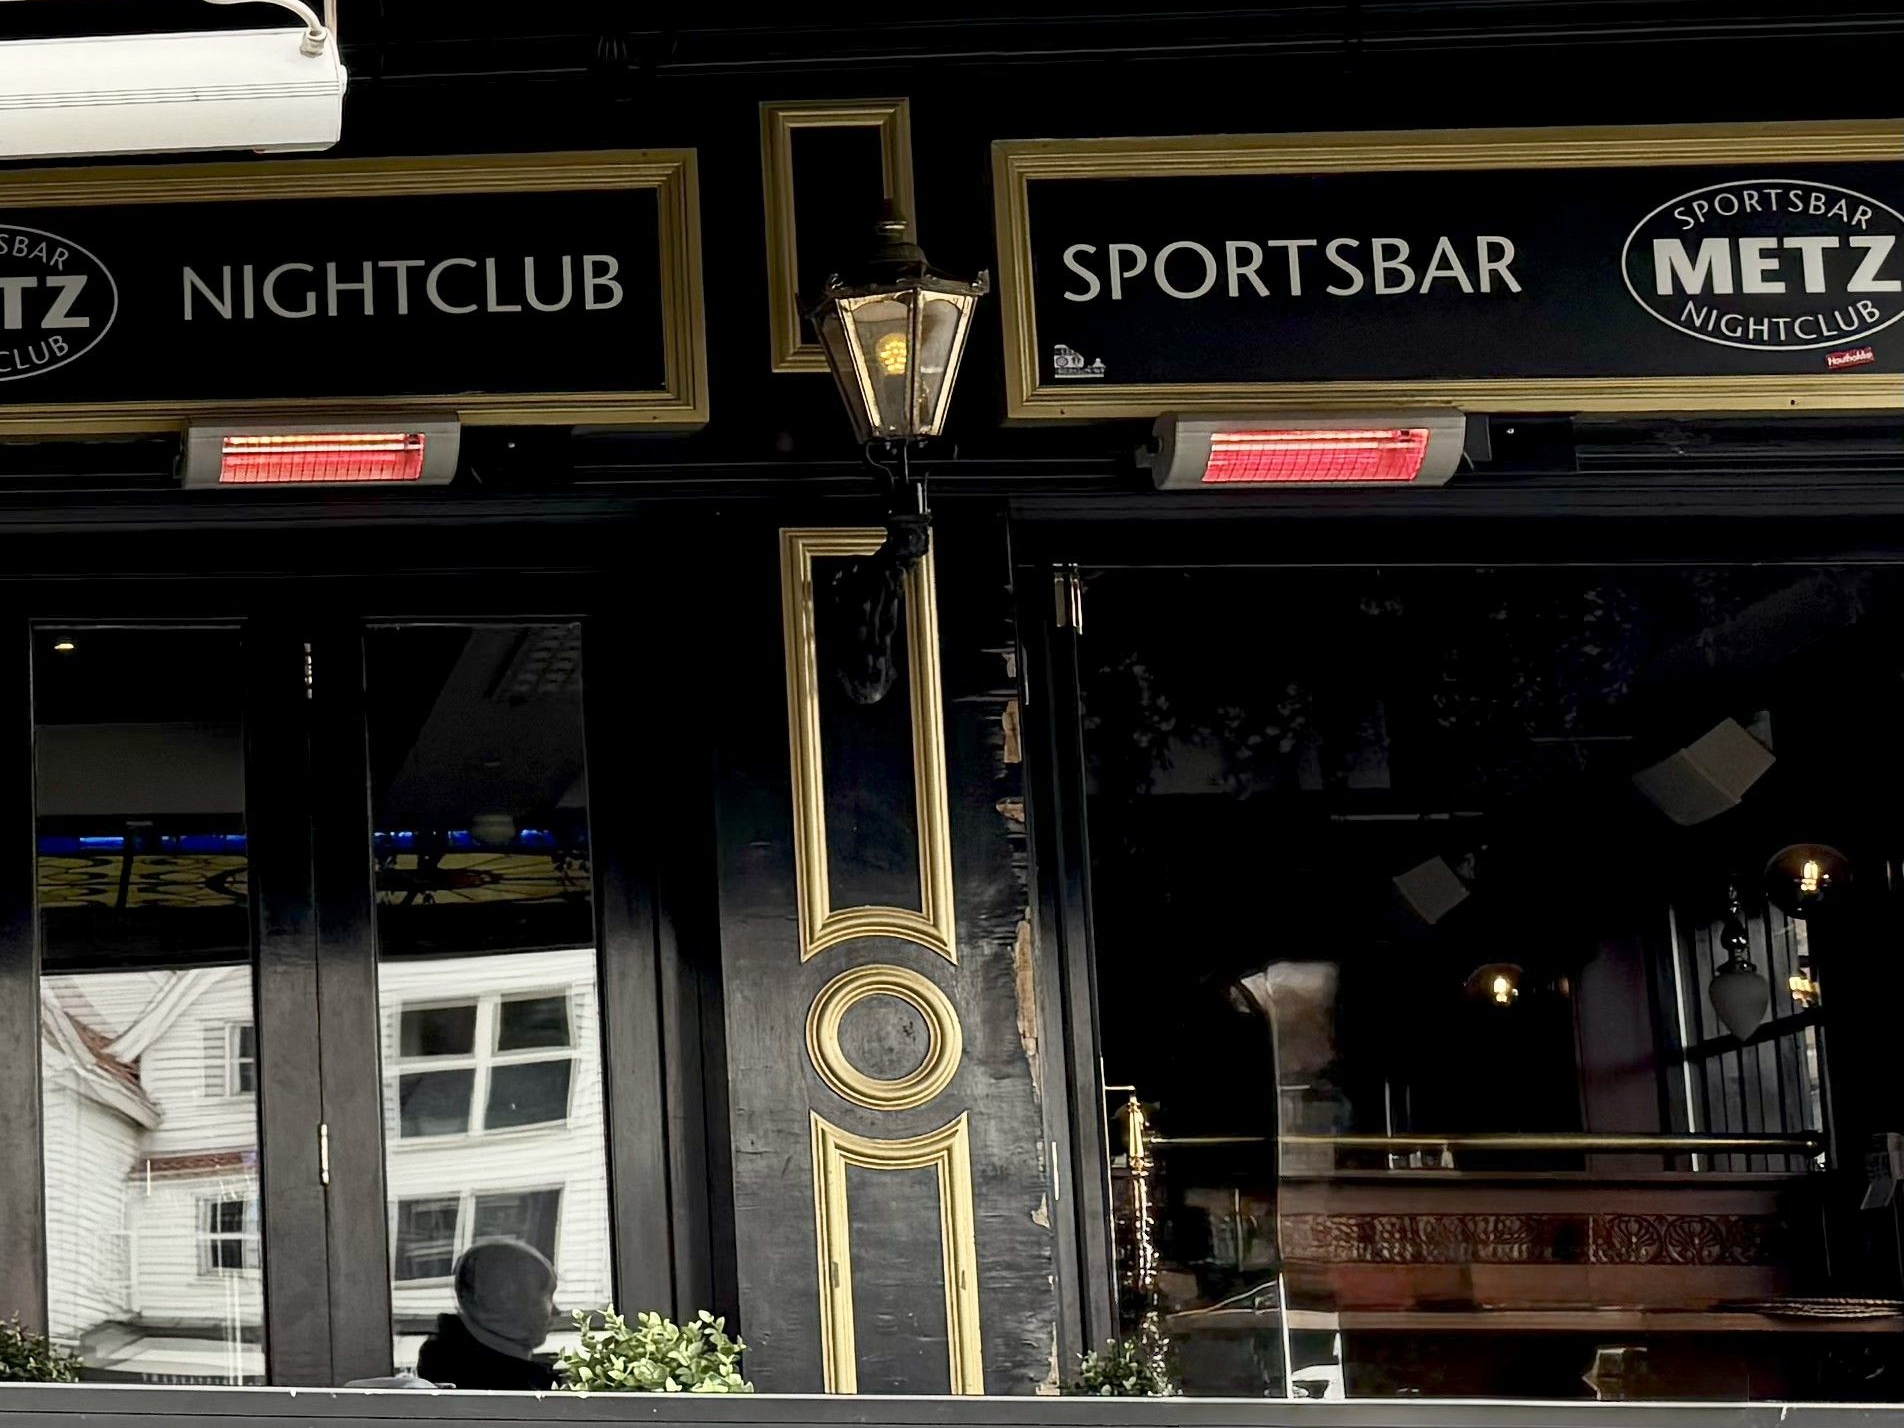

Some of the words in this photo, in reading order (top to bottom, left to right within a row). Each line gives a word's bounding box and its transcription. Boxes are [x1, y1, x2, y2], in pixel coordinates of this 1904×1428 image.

[1673, 187, 1874, 230] SPORTSBAR
[182, 254, 624, 321] NIGHTCLUB
[1062, 235, 1523, 303] SPORTSBAR
[1652, 234, 1903, 296] METZ
[1680, 299, 1882, 343] NIGHTCLUB
